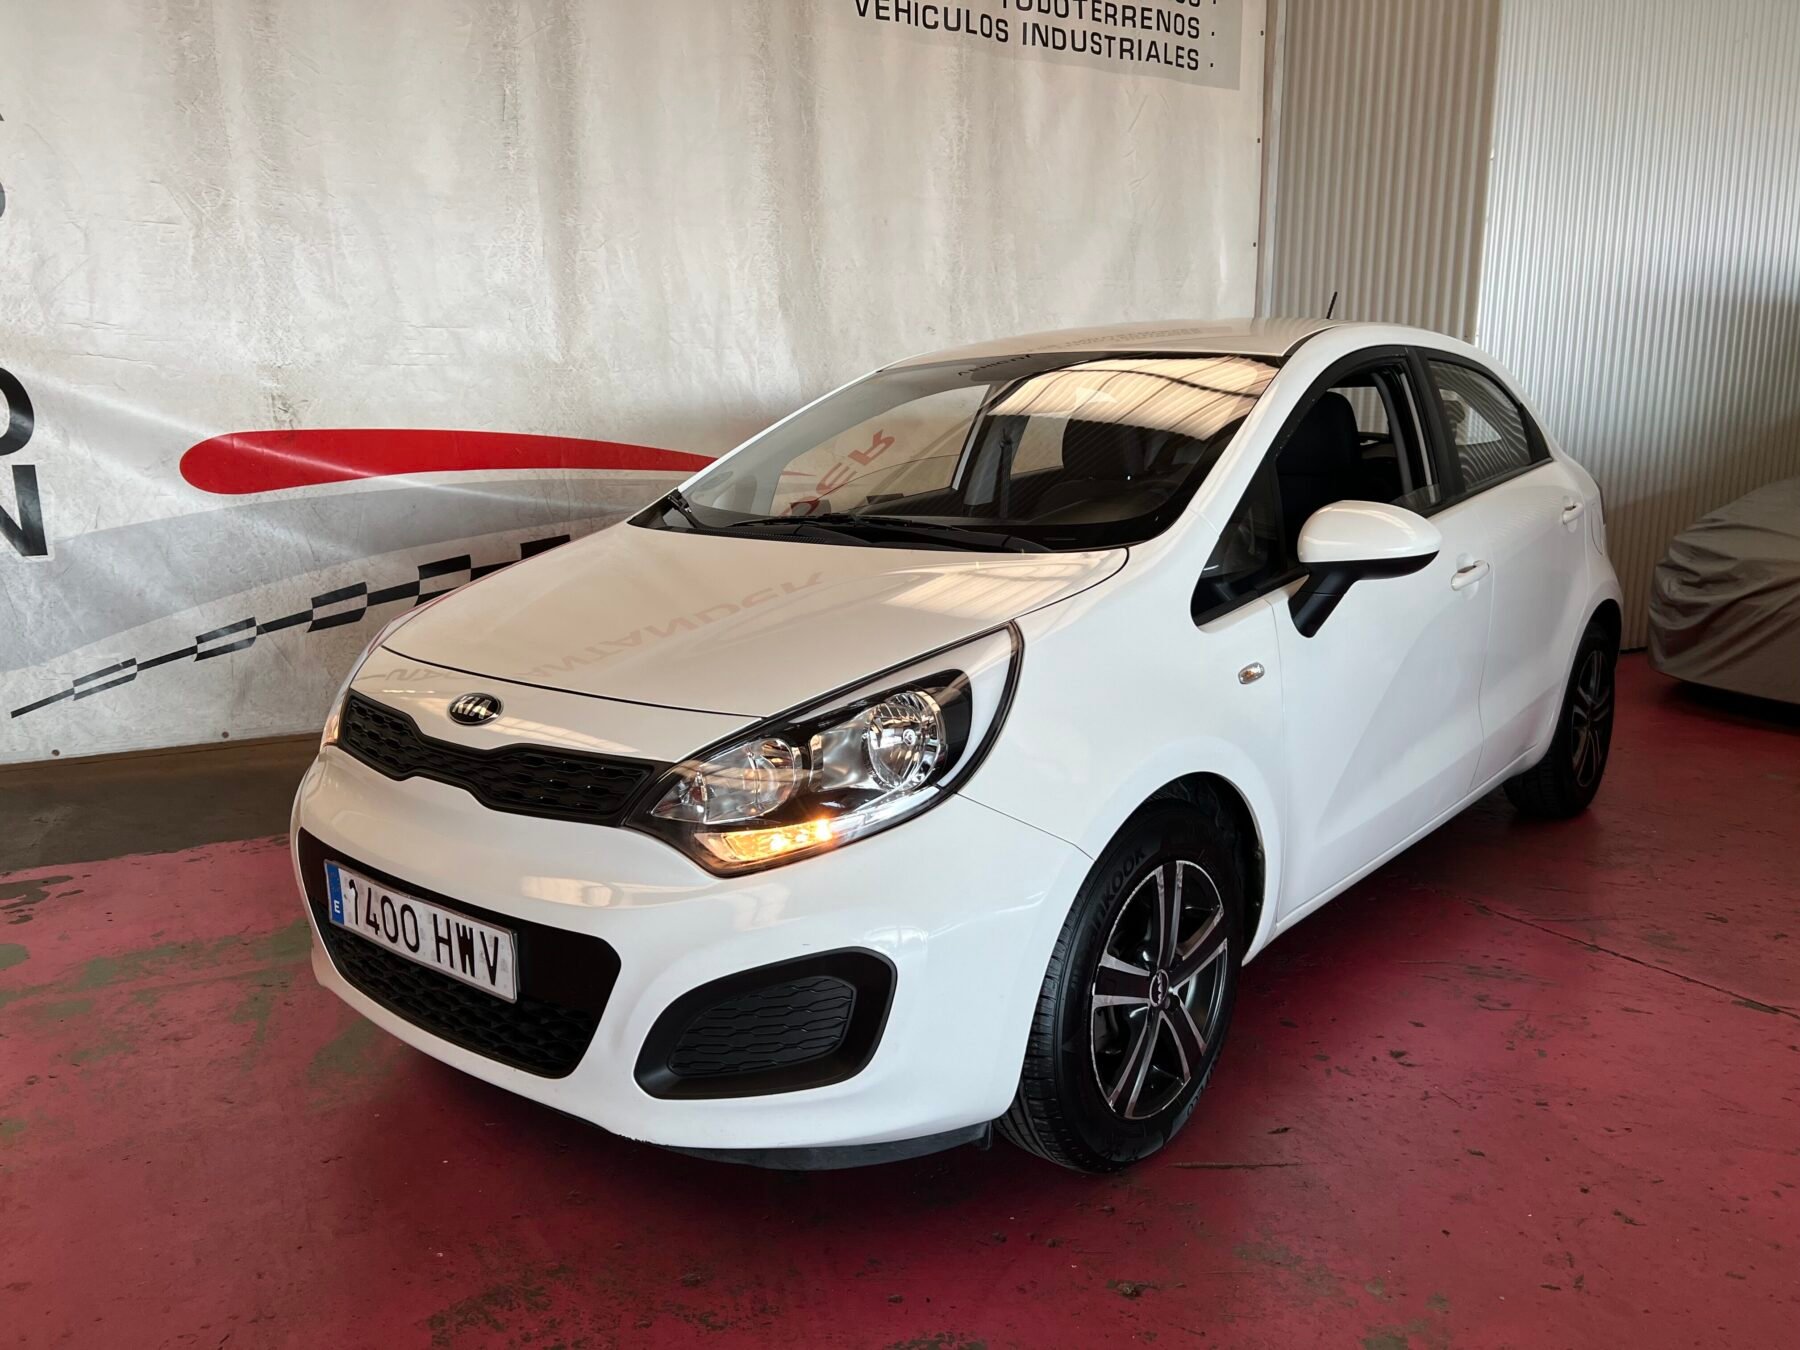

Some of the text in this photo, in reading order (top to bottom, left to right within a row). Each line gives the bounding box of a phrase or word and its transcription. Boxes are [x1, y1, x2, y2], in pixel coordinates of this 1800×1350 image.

[856, 0, 1009, 43] VEHICULOS
[1021, 22, 1199, 71] INDUSTRIALES
[452, 696, 492, 720] KIA
[333, 899, 341, 915] E
[348, 879, 499, 986] 1400 HWV
